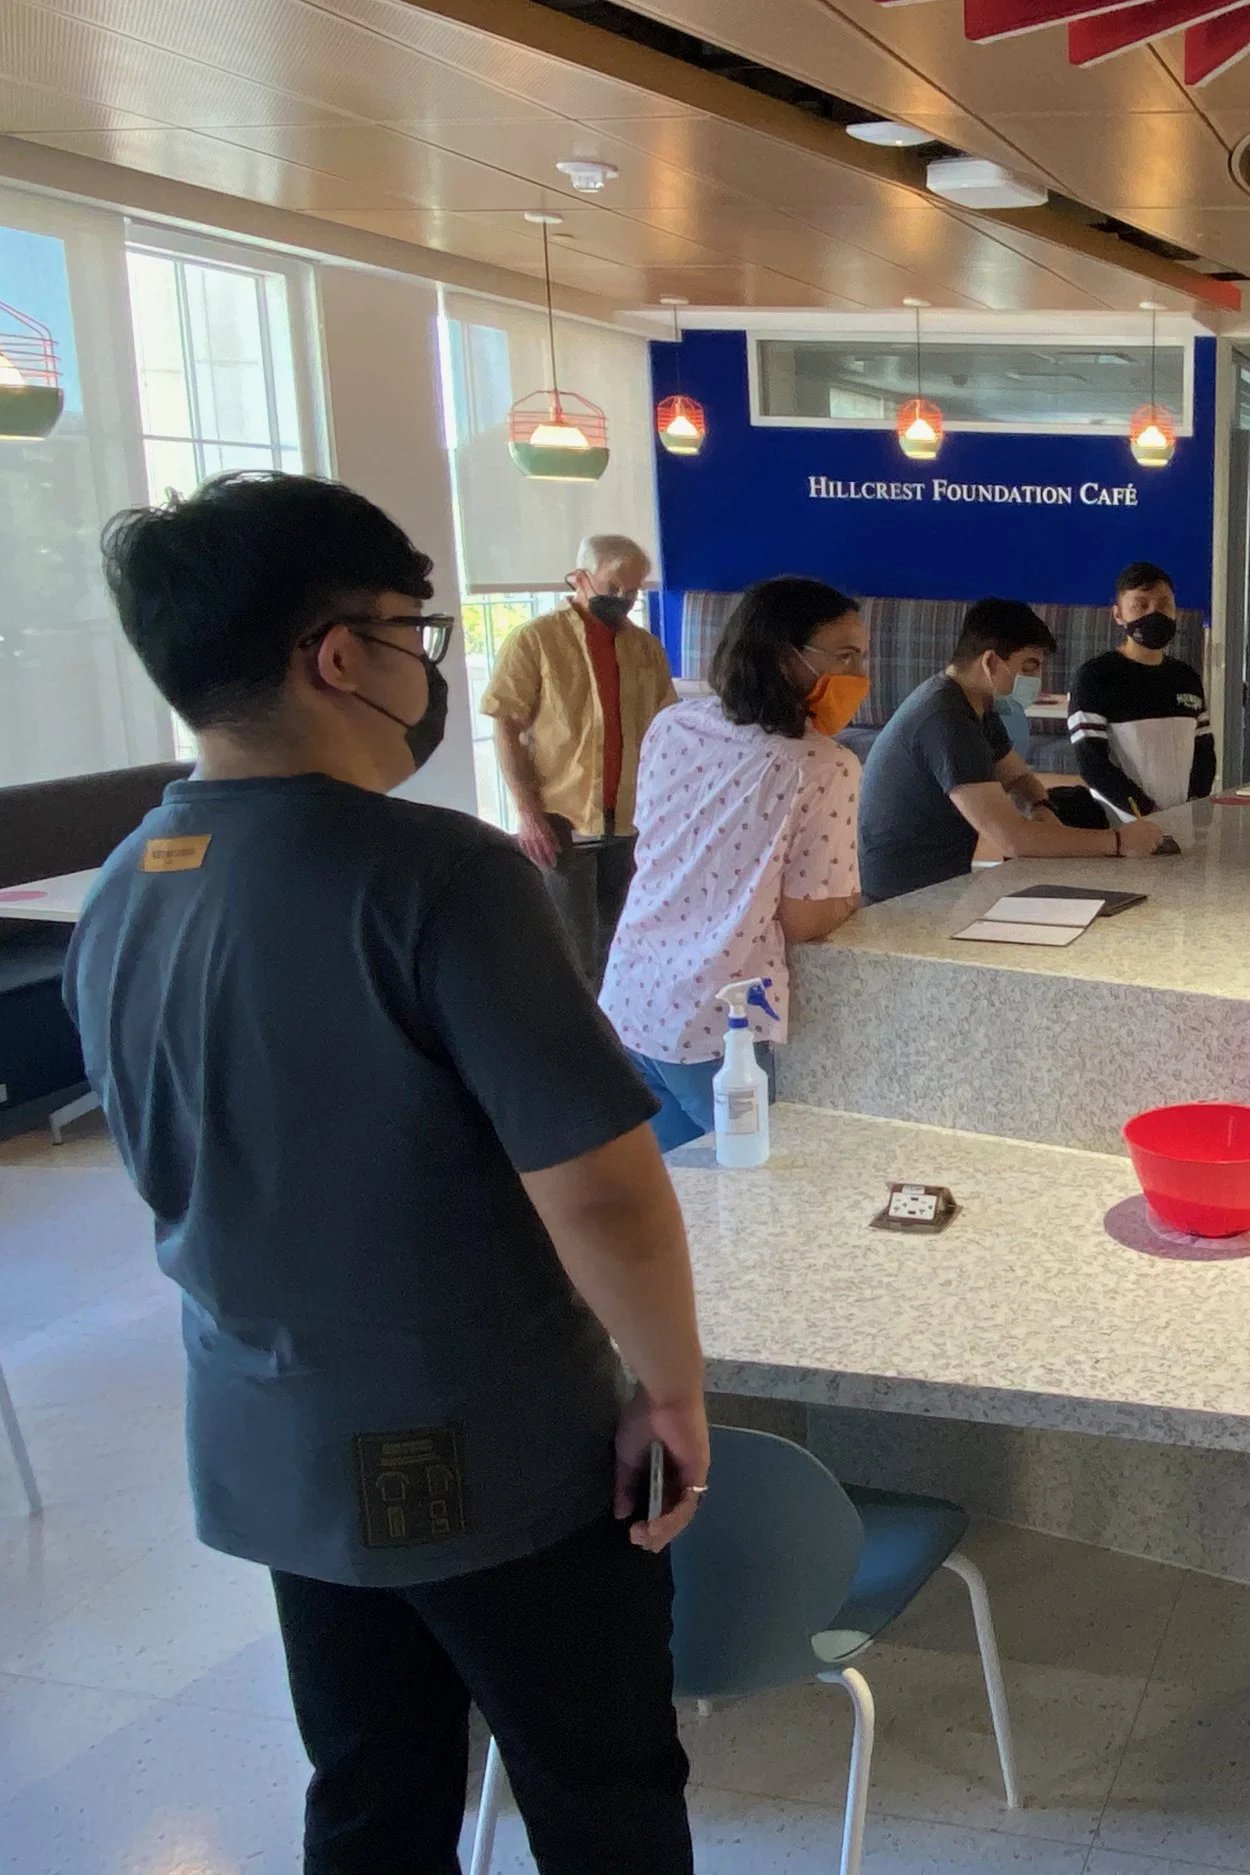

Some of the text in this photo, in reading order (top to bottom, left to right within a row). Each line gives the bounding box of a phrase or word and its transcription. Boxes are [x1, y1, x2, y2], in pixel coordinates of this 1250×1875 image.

[808, 475, 1138, 506] HILLCREST FOUNDATION CAFÉ
